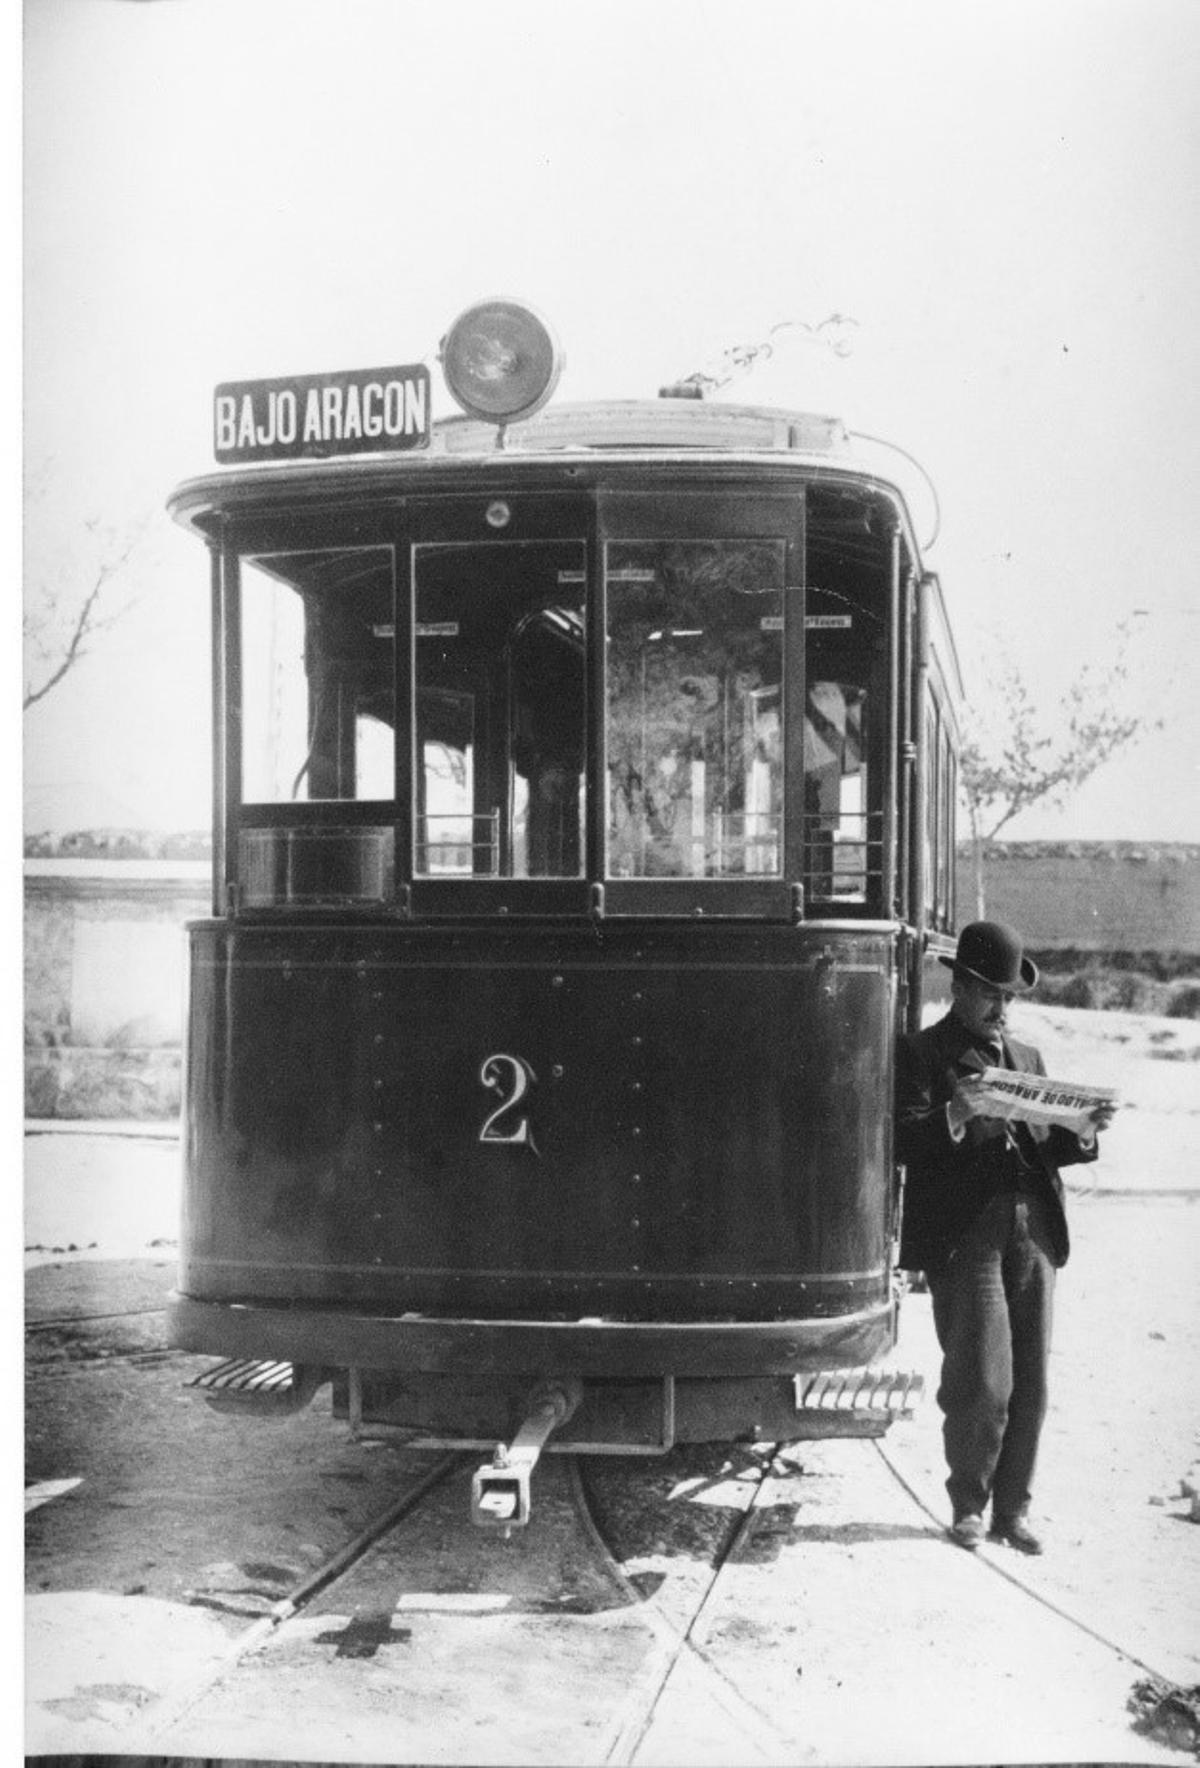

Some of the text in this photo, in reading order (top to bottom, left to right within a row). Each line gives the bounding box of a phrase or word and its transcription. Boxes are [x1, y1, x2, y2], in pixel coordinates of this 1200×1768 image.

[216, 379, 425, 450] BAJO ARAGON
[480, 1054, 527, 1142] 2
